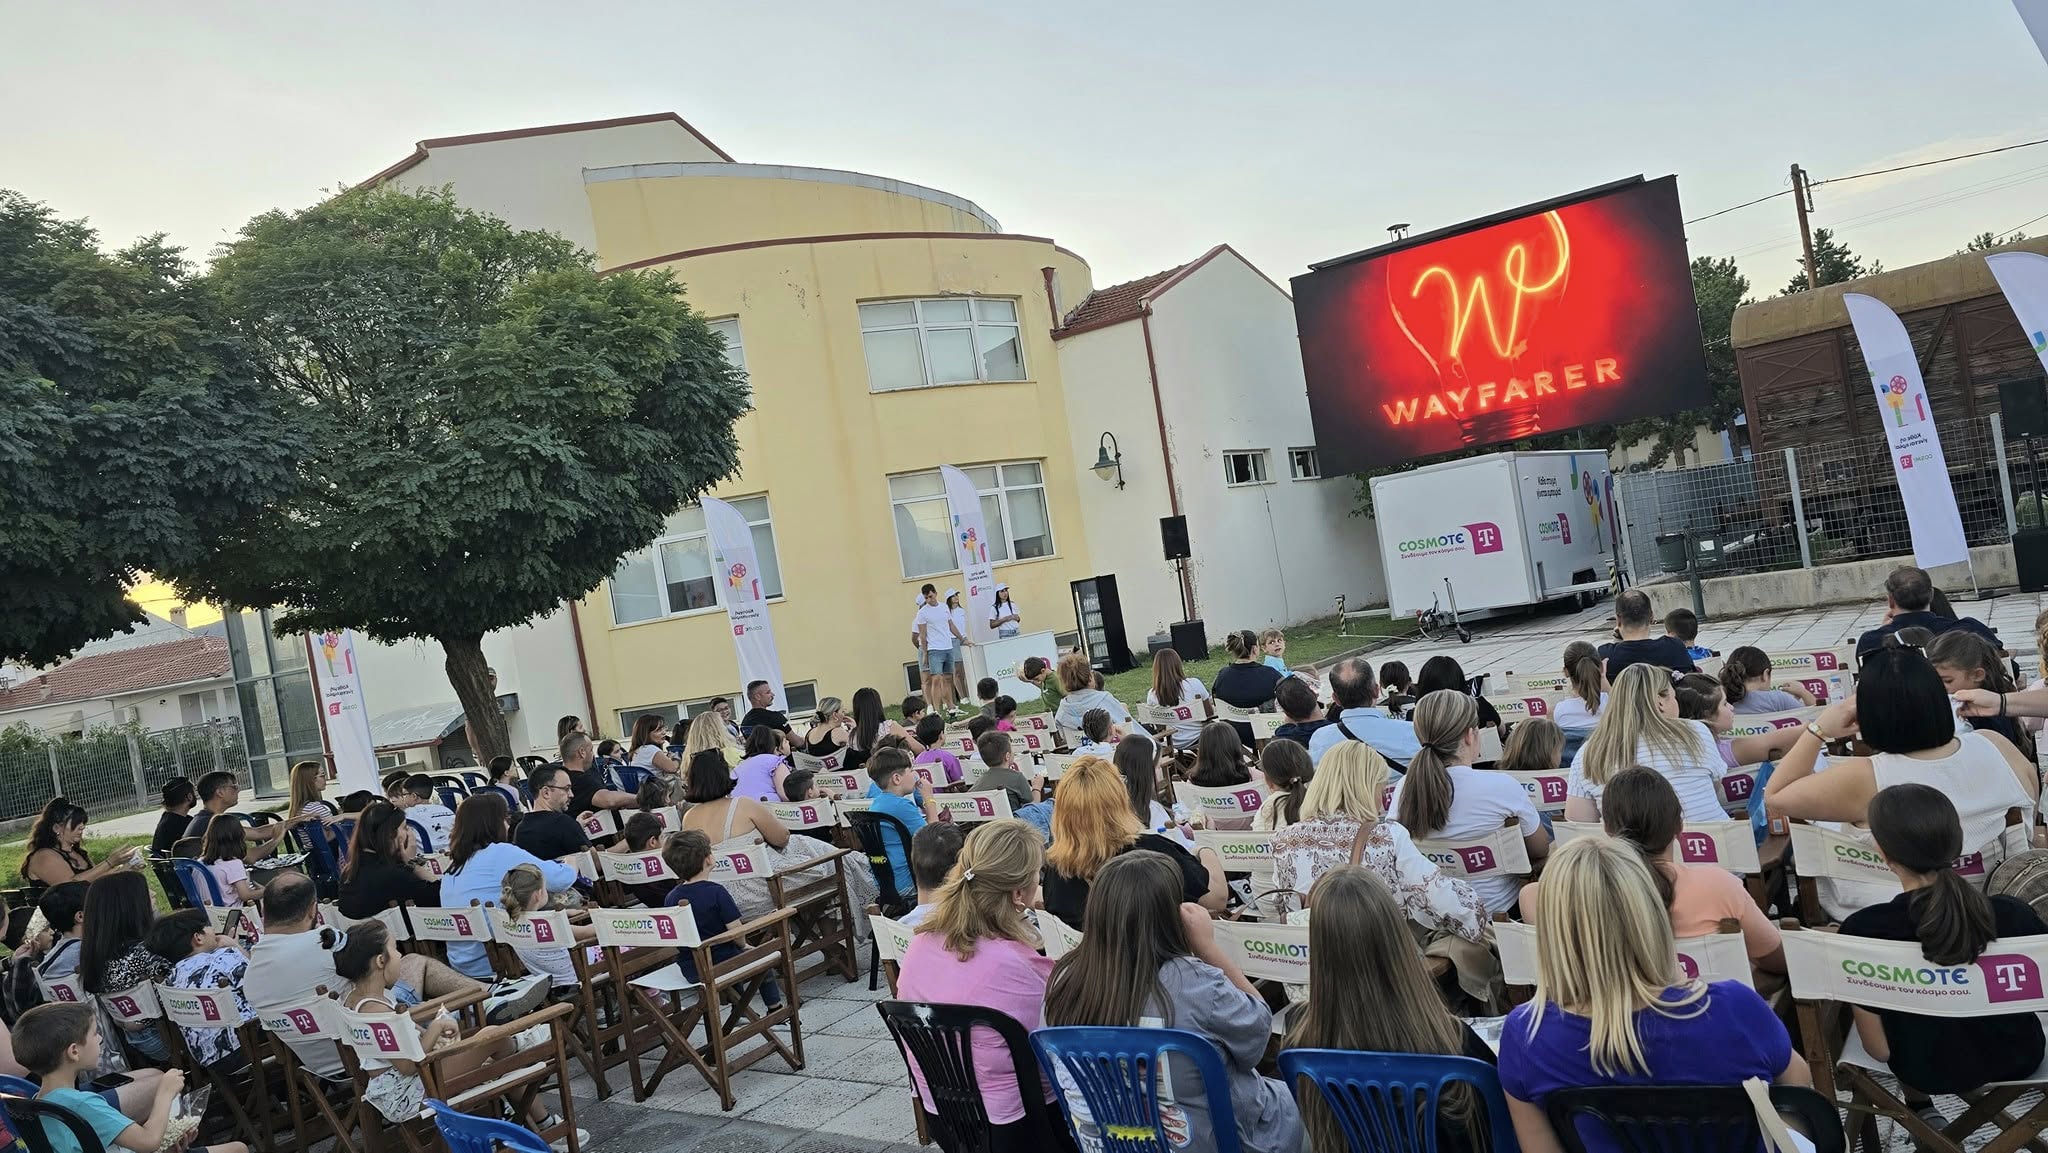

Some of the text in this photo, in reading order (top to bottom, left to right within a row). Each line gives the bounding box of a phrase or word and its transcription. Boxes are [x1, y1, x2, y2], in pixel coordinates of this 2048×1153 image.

[1382, 356, 1622, 426] WAYFARER
[1398, 527, 1496, 552] COSMOTE T
[1771, 655, 1832, 667] OSMOTE T
[1527, 678, 1567, 687] COSMOTE
[1809, 682, 1822, 695] T
[1493, 701, 1543, 712] SMOTE T
[1547, 781, 1562, 797] T
[1730, 778, 1747, 796] T
[940, 801, 990, 812] COSMOTE T
[1200, 793, 1256, 807] SMOTE T
[775, 809, 800, 818] COSMOTE
[1221, 843, 1271, 854] COSMOT
[1687, 838, 1707, 857] T
[613, 859, 658, 872] COSMOTE T
[735, 857, 748, 870] T
[1468, 850, 1486, 868] T
[424, 917, 454, 927] COSMOTE
[459, 918, 468, 932] T
[538, 923, 549, 938] T
[612, 919, 653, 929] COSMOTE
[660, 919, 672, 934] T
[1243, 939, 1308, 958] COSMOT
[1841, 959, 2027, 992] COSMOTE T
[1846, 976, 1972, 997] Συνδέουμε τον κόσμο σου.
[169, 999, 200, 1011] COSMOTE
[203, 1000, 215, 1016] T
[296, 1013, 311, 1029] T
[378, 1028, 391, 1046] T
